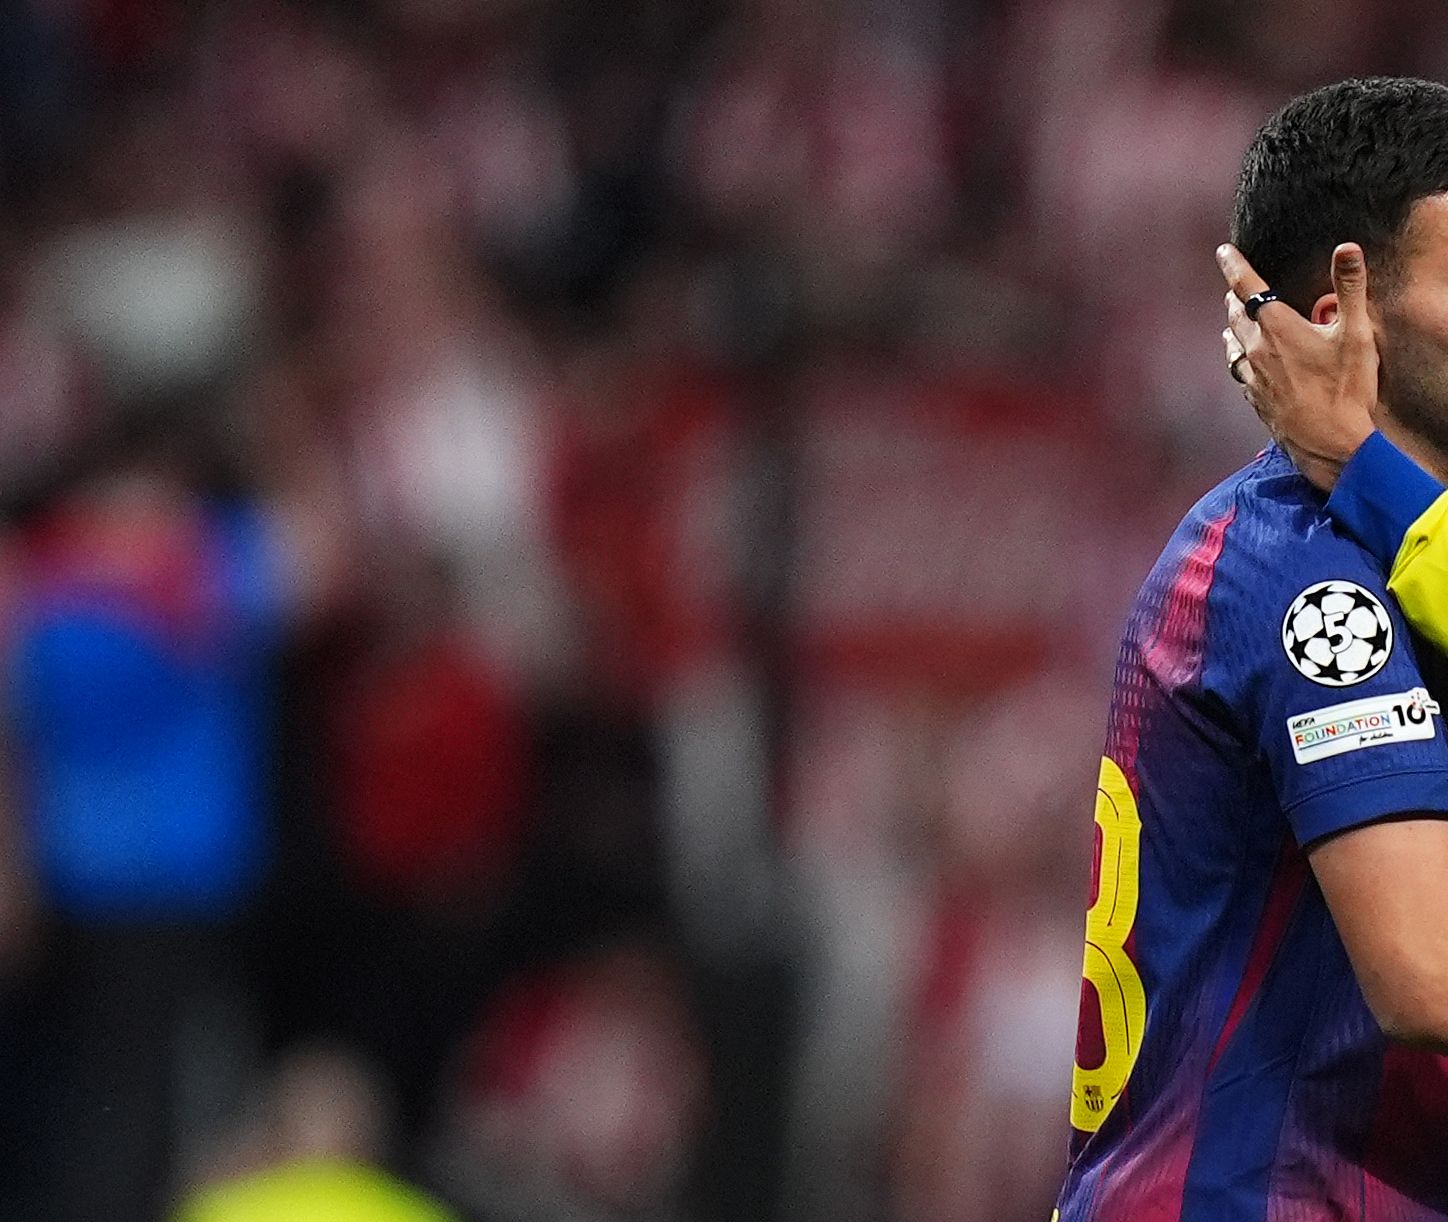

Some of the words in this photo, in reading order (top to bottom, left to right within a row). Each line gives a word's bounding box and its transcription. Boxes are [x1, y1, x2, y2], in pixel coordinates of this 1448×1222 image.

[1324, 611, 1354, 654] 5
[1295, 713, 1391, 747] FOUNDATION
[1392, 704, 1427, 727] 10
